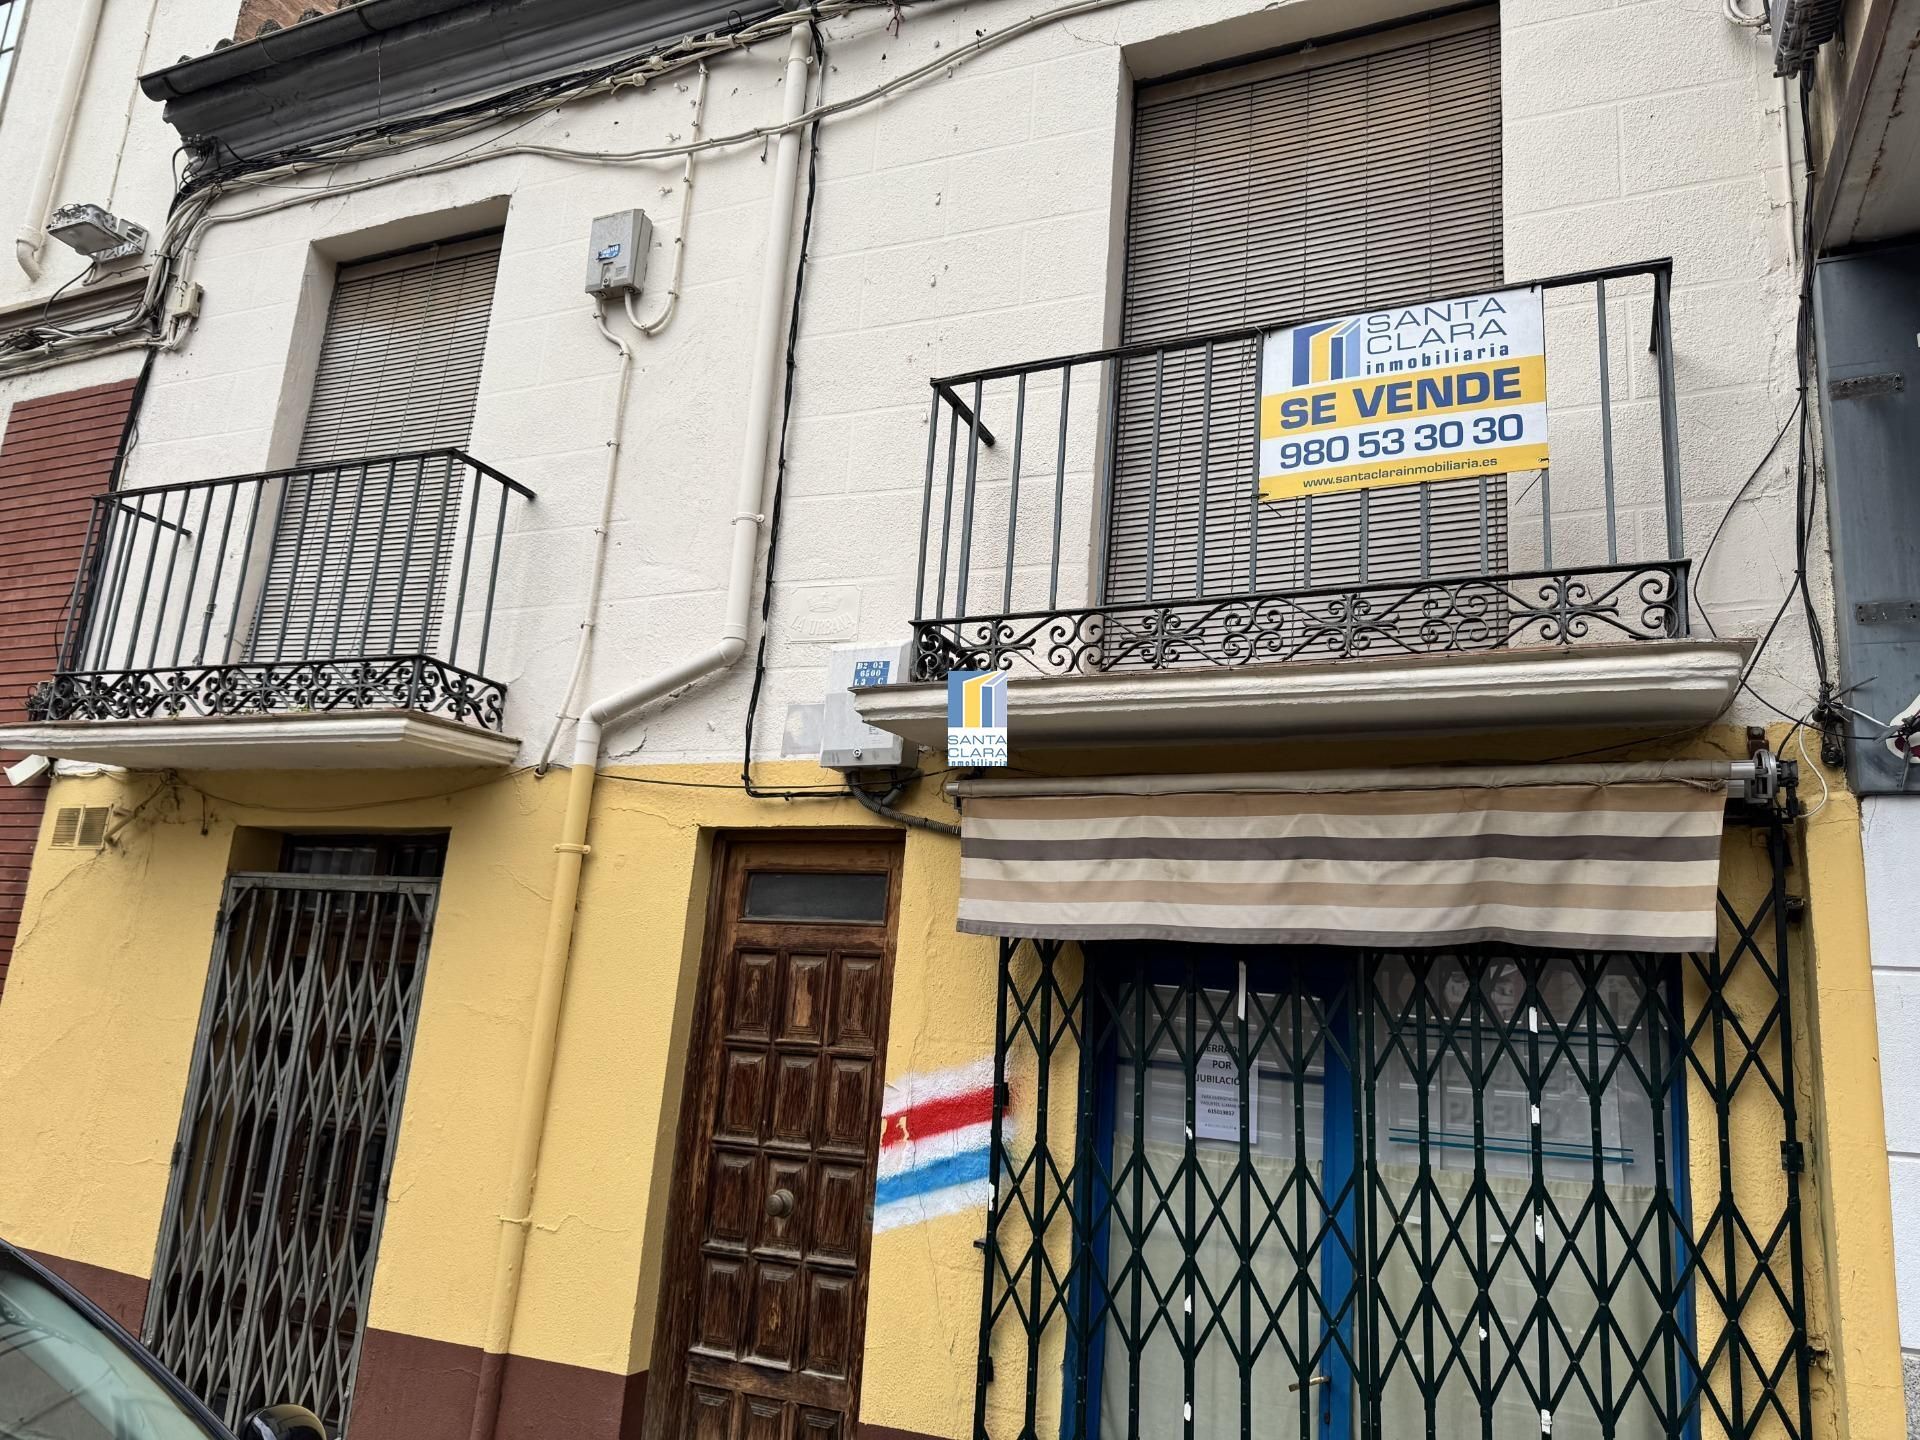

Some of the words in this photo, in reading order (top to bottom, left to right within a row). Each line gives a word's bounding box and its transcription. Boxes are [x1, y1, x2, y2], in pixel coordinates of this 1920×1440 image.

[1367, 297, 1507, 333] SANTA
[1367, 319, 1507, 355] CLARA
[1366, 343, 1509, 375] inmobiliaria
[1280, 392, 1337, 430] SE
[1352, 366, 1521, 418] VENDE
[1280, 436, 1349, 470] 980
[1358, 428, 1405, 458] 53
[1414, 421, 1464, 451] 30
[1473, 413, 1524, 444] 30
[1303, 457, 1498, 488] www.santaclarainmobiliaria.es
[1212, 1060, 1232, 1070] POR
